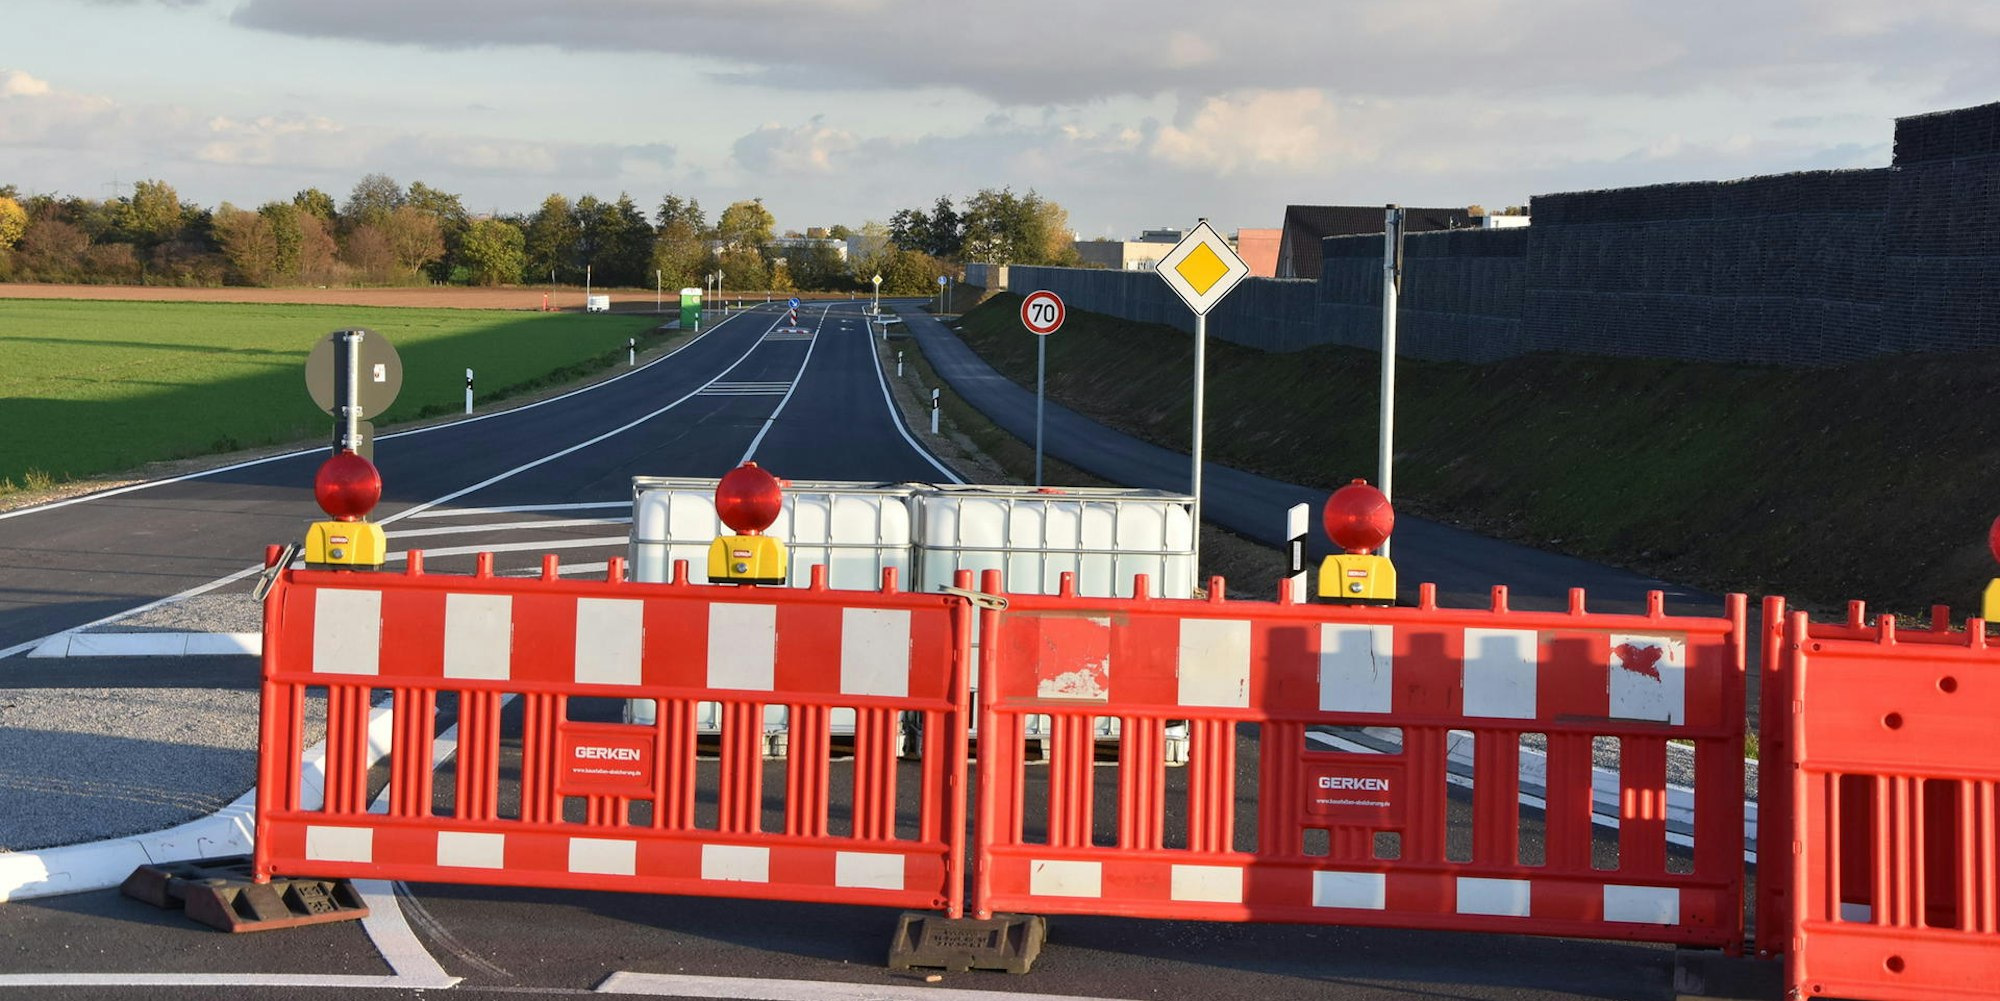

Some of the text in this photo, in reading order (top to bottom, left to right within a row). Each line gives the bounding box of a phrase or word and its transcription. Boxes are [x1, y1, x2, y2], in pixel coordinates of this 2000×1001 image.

[1032, 304, 1055, 323] 70
[575, 746, 640, 761] GERKEN
[1318, 776, 1389, 791] GERKEN
